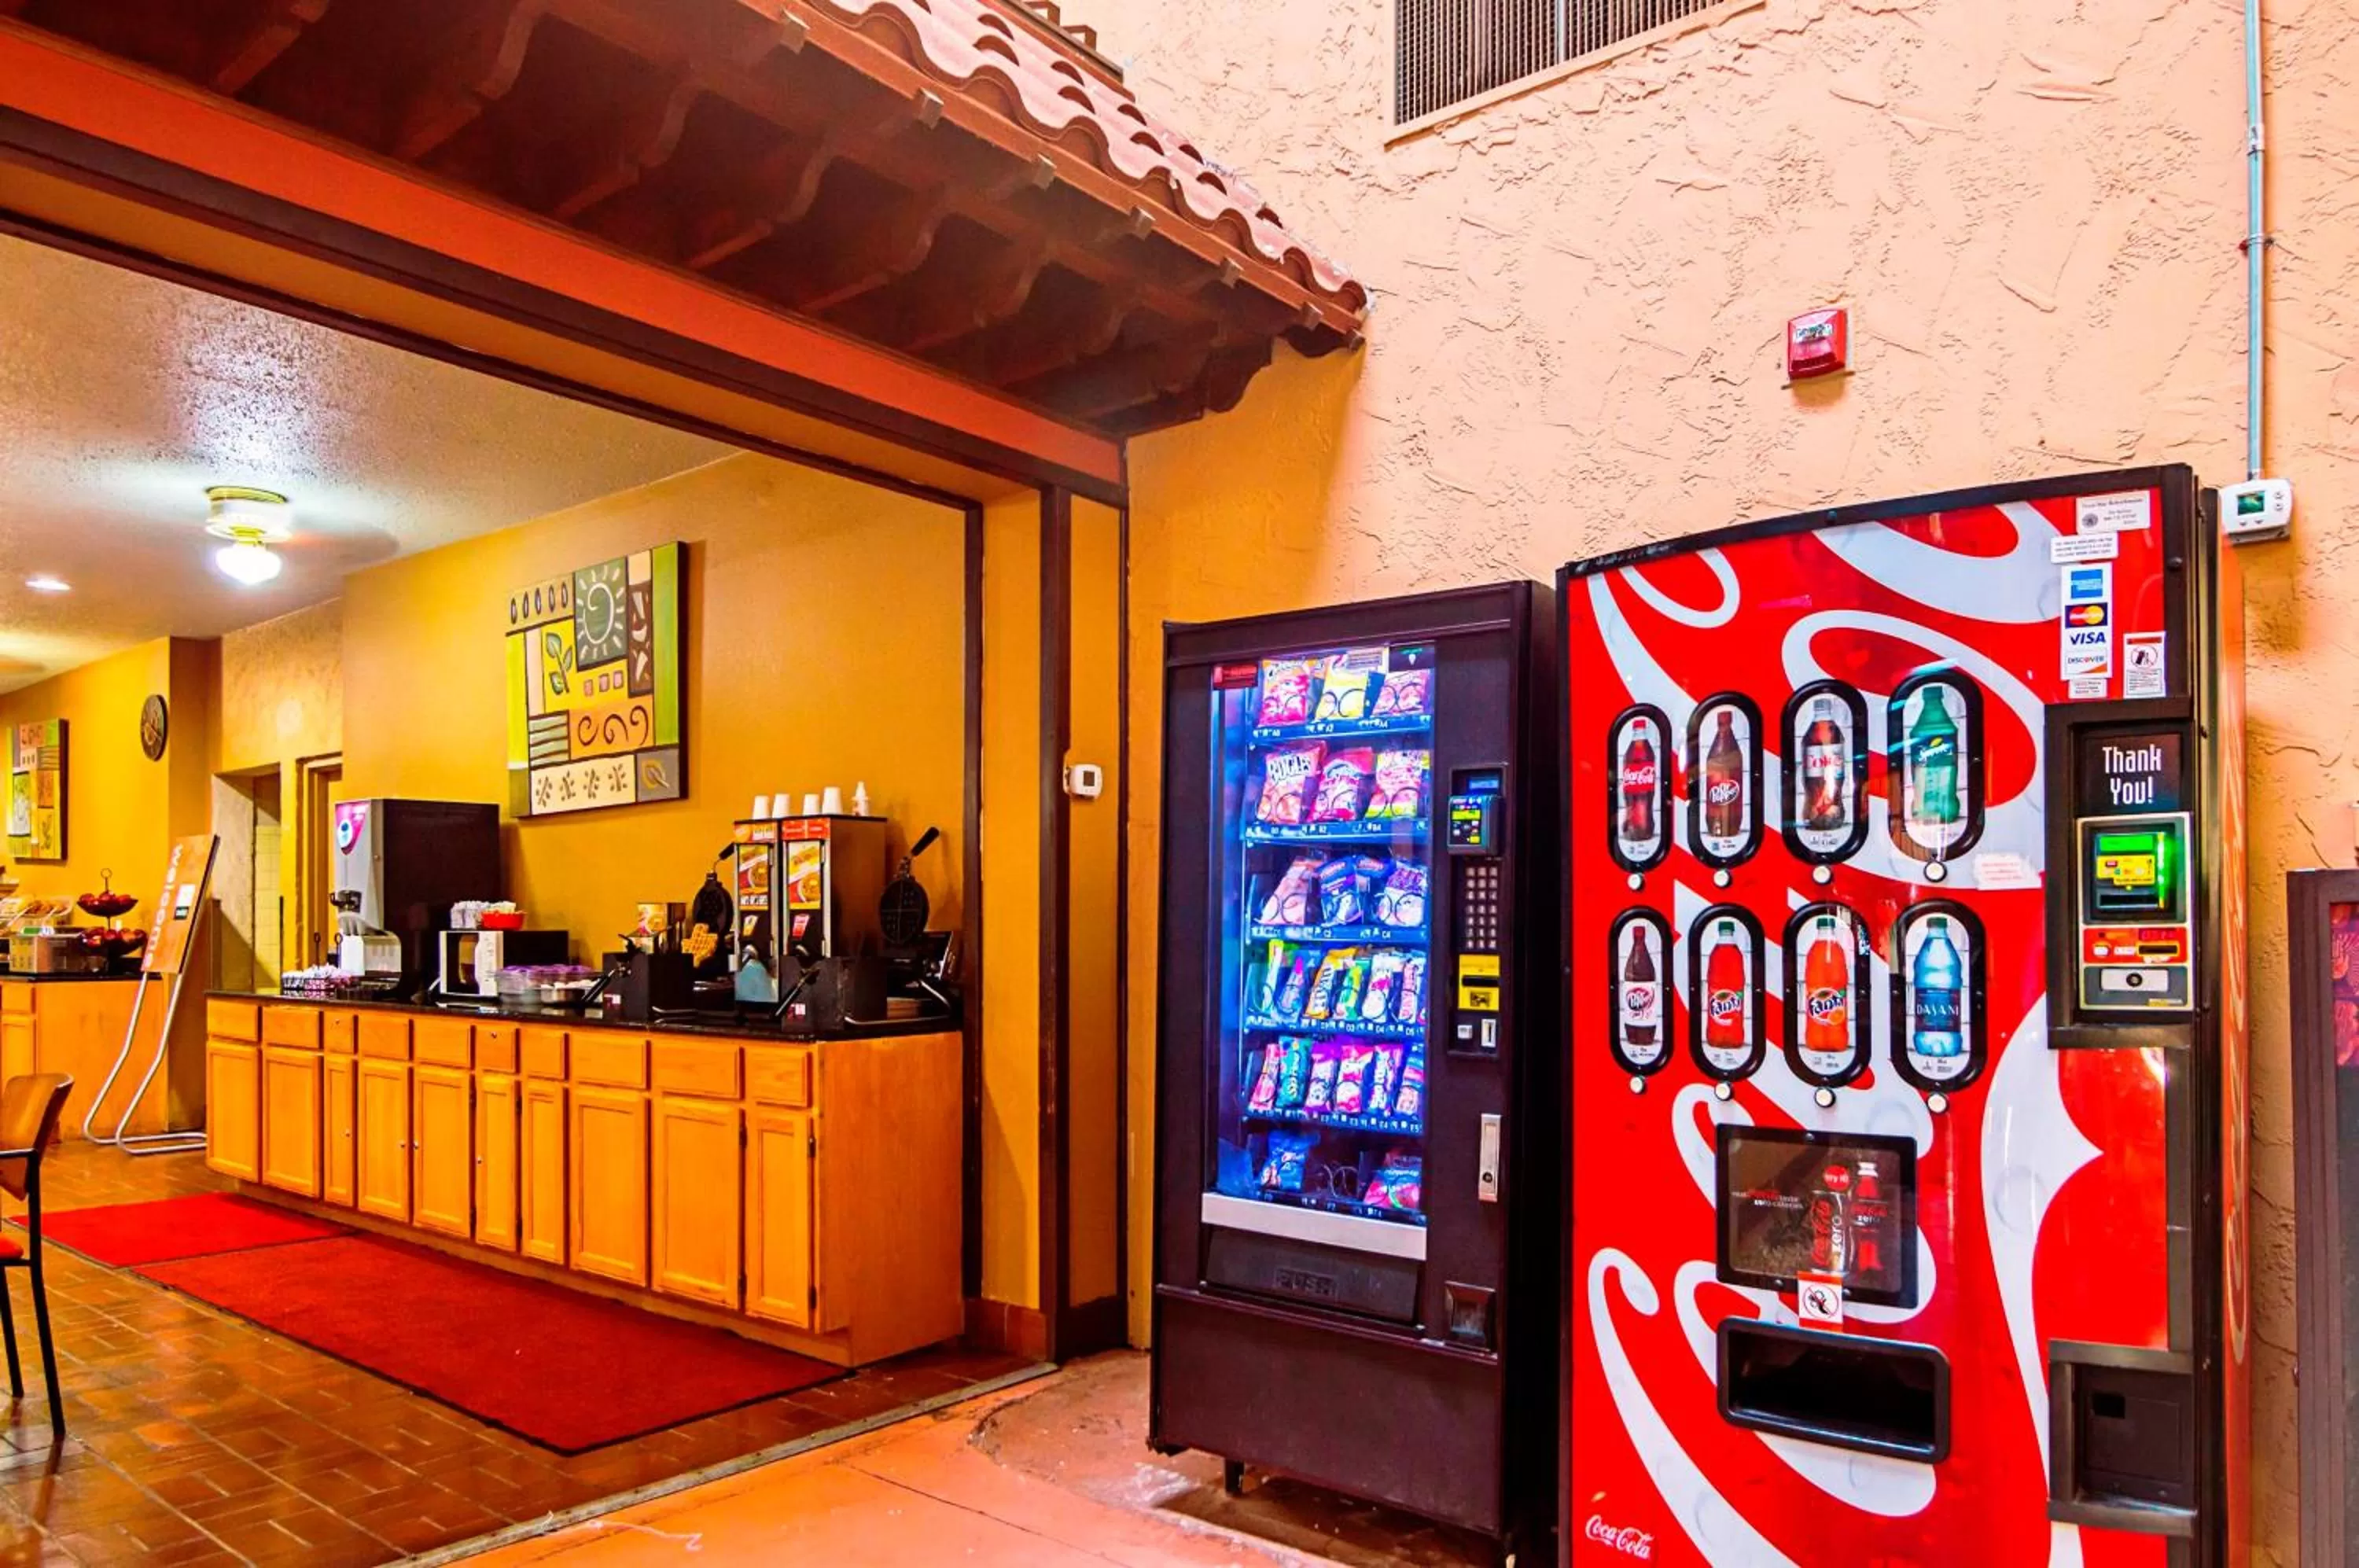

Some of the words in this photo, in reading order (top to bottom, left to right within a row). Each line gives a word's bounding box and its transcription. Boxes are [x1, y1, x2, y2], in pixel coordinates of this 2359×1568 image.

[2070, 631, 2106, 645] VISA
[2102, 743, 2162, 774] Thank
[1623, 766, 1655, 786] Coca-Cola
[2110, 775, 2153, 805] You!
[1916, 1003, 1958, 1016] DASANI
[1585, 1515, 1654, 1560] Coca-Cola
